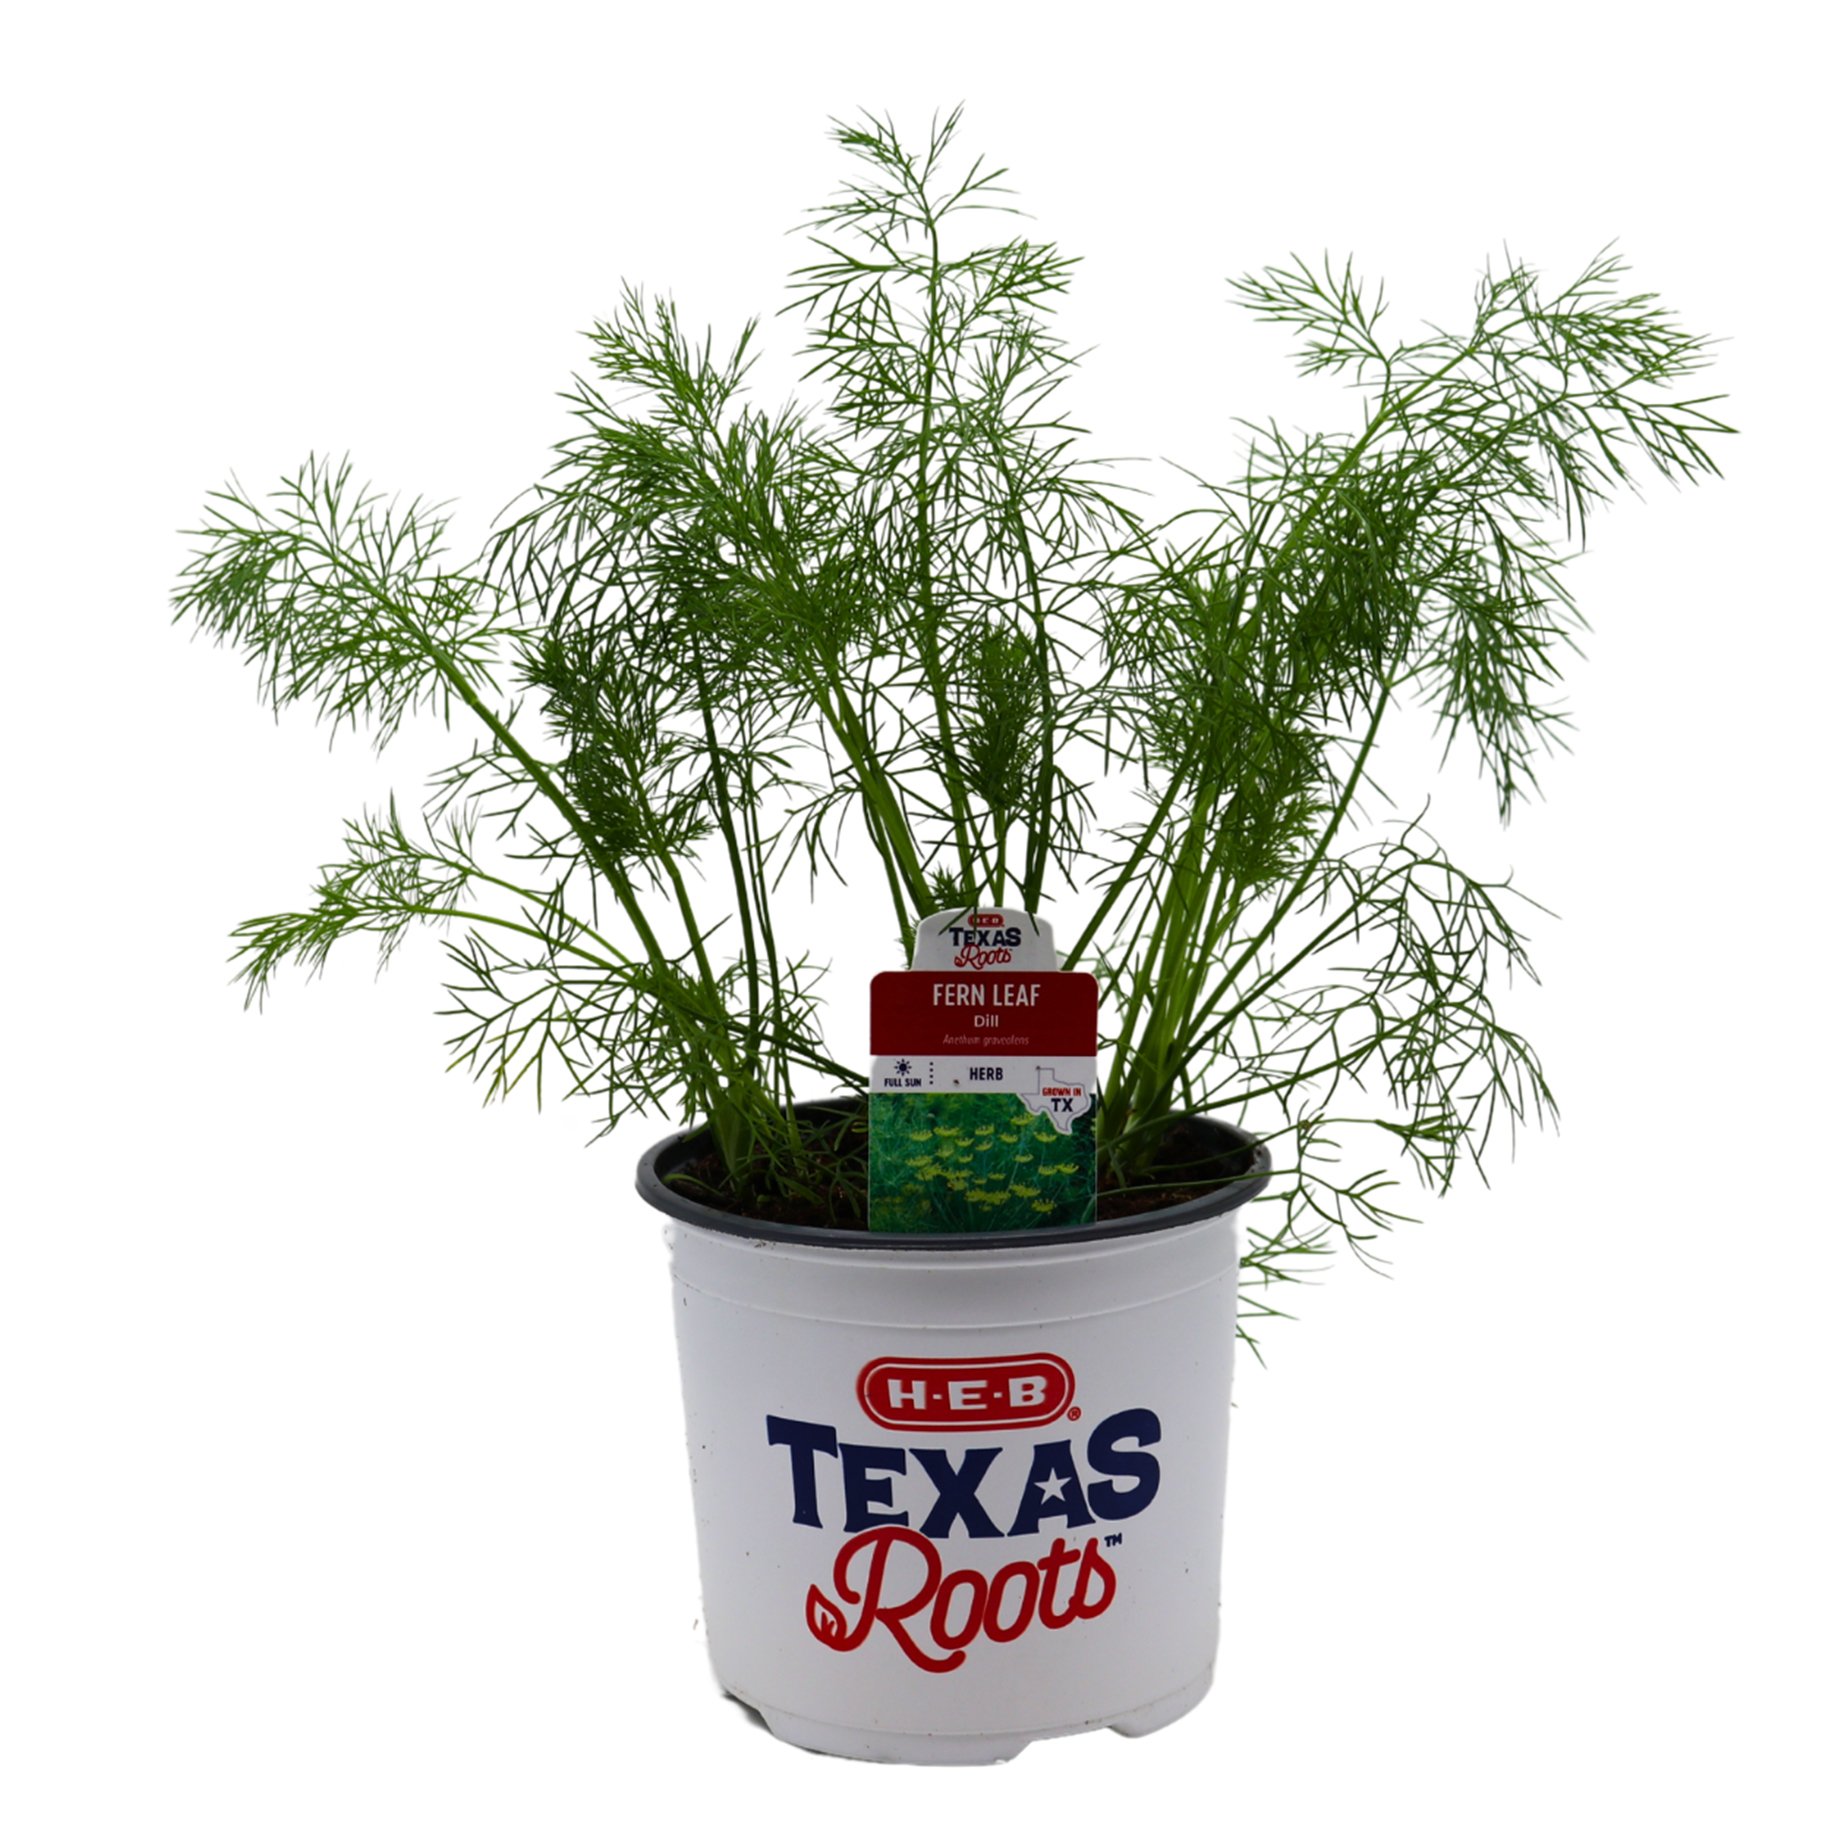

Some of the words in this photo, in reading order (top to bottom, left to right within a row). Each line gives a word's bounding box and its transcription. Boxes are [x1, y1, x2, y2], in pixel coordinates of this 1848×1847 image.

[949, 927, 1021, 947] TEXAS
[954, 943, 1012, 969] Roots
[933, 983, 985, 1006] FERN
[992, 983, 1041, 1007] LEAF
[974, 1014, 999, 1028] Dill
[942, 1034, 981, 1045] Anethum
[983, 1034, 1029, 1047] graveolens
[969, 1067, 1004, 1081] HERB
[884, 1078, 902, 1087] FULL
[905, 1078, 922, 1087] SUN
[1042, 1087, 1071, 1097] GROWN
[1073, 1088, 1082, 1097] IN
[1051, 1098, 1074, 1112] TX
[766, 1407, 1162, 1539] TEXAS
[805, 1525, 1117, 1674] Roots
